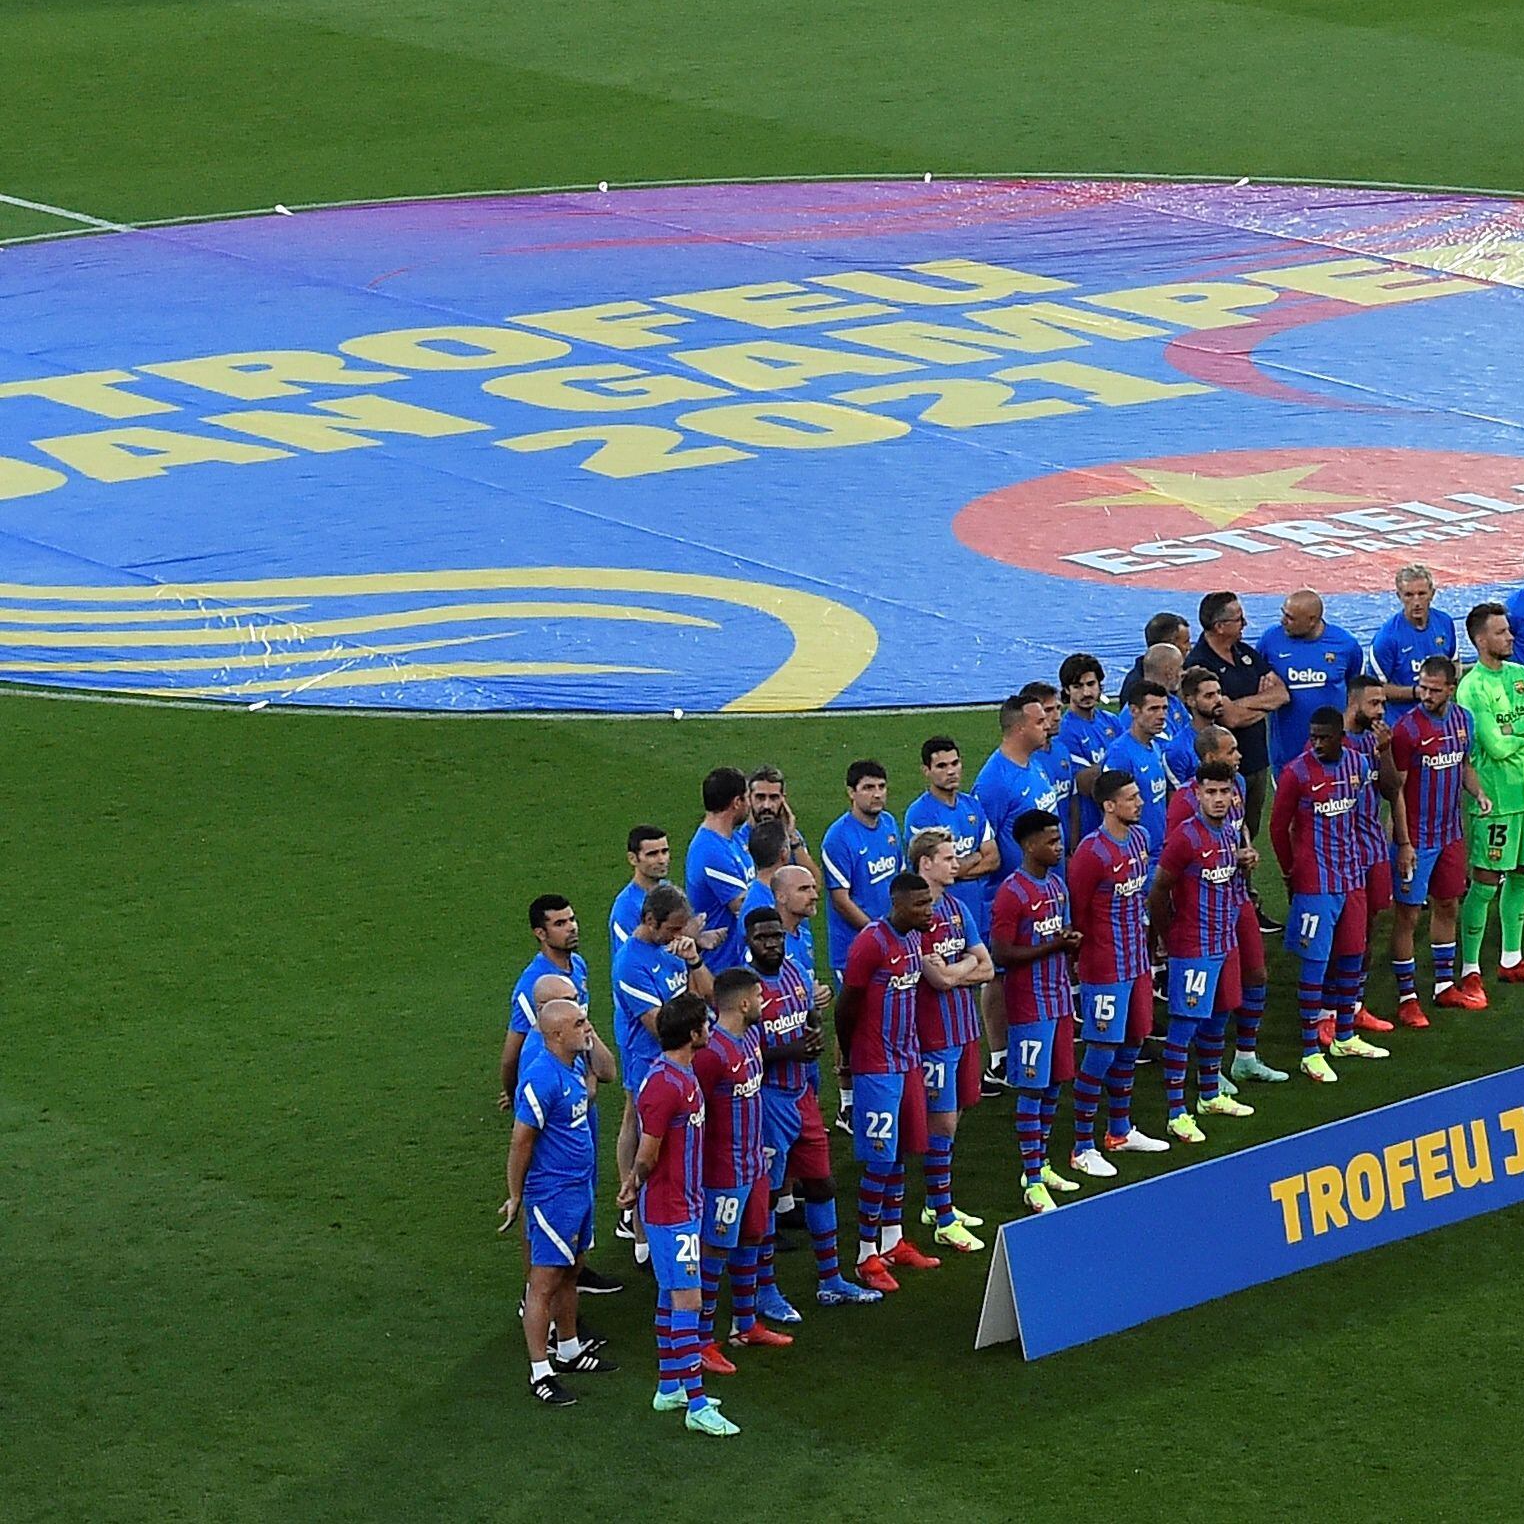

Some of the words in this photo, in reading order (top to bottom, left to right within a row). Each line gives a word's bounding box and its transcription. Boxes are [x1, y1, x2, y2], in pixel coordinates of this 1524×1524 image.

[0, 258, 1079, 420] TROFEU
[492, 360, 1223, 479] 2021
[1288, 667, 1327, 684] beko
[1487, 823, 1508, 847] 13
[868, 855, 896, 875] beko
[1300, 913, 1320, 939] 11
[1184, 969, 1207, 997] 14
[1093, 995, 1116, 1021] 15
[763, 1009, 808, 1035] Rakute
[1020, 1040, 1042, 1066] 17
[923, 1061, 945, 1088] 21
[866, 1112, 893, 1139] 22
[1270, 1120, 1496, 1244] TROFEU
[715, 1195, 739, 1226] 18
[675, 1234, 700, 1263] 20
